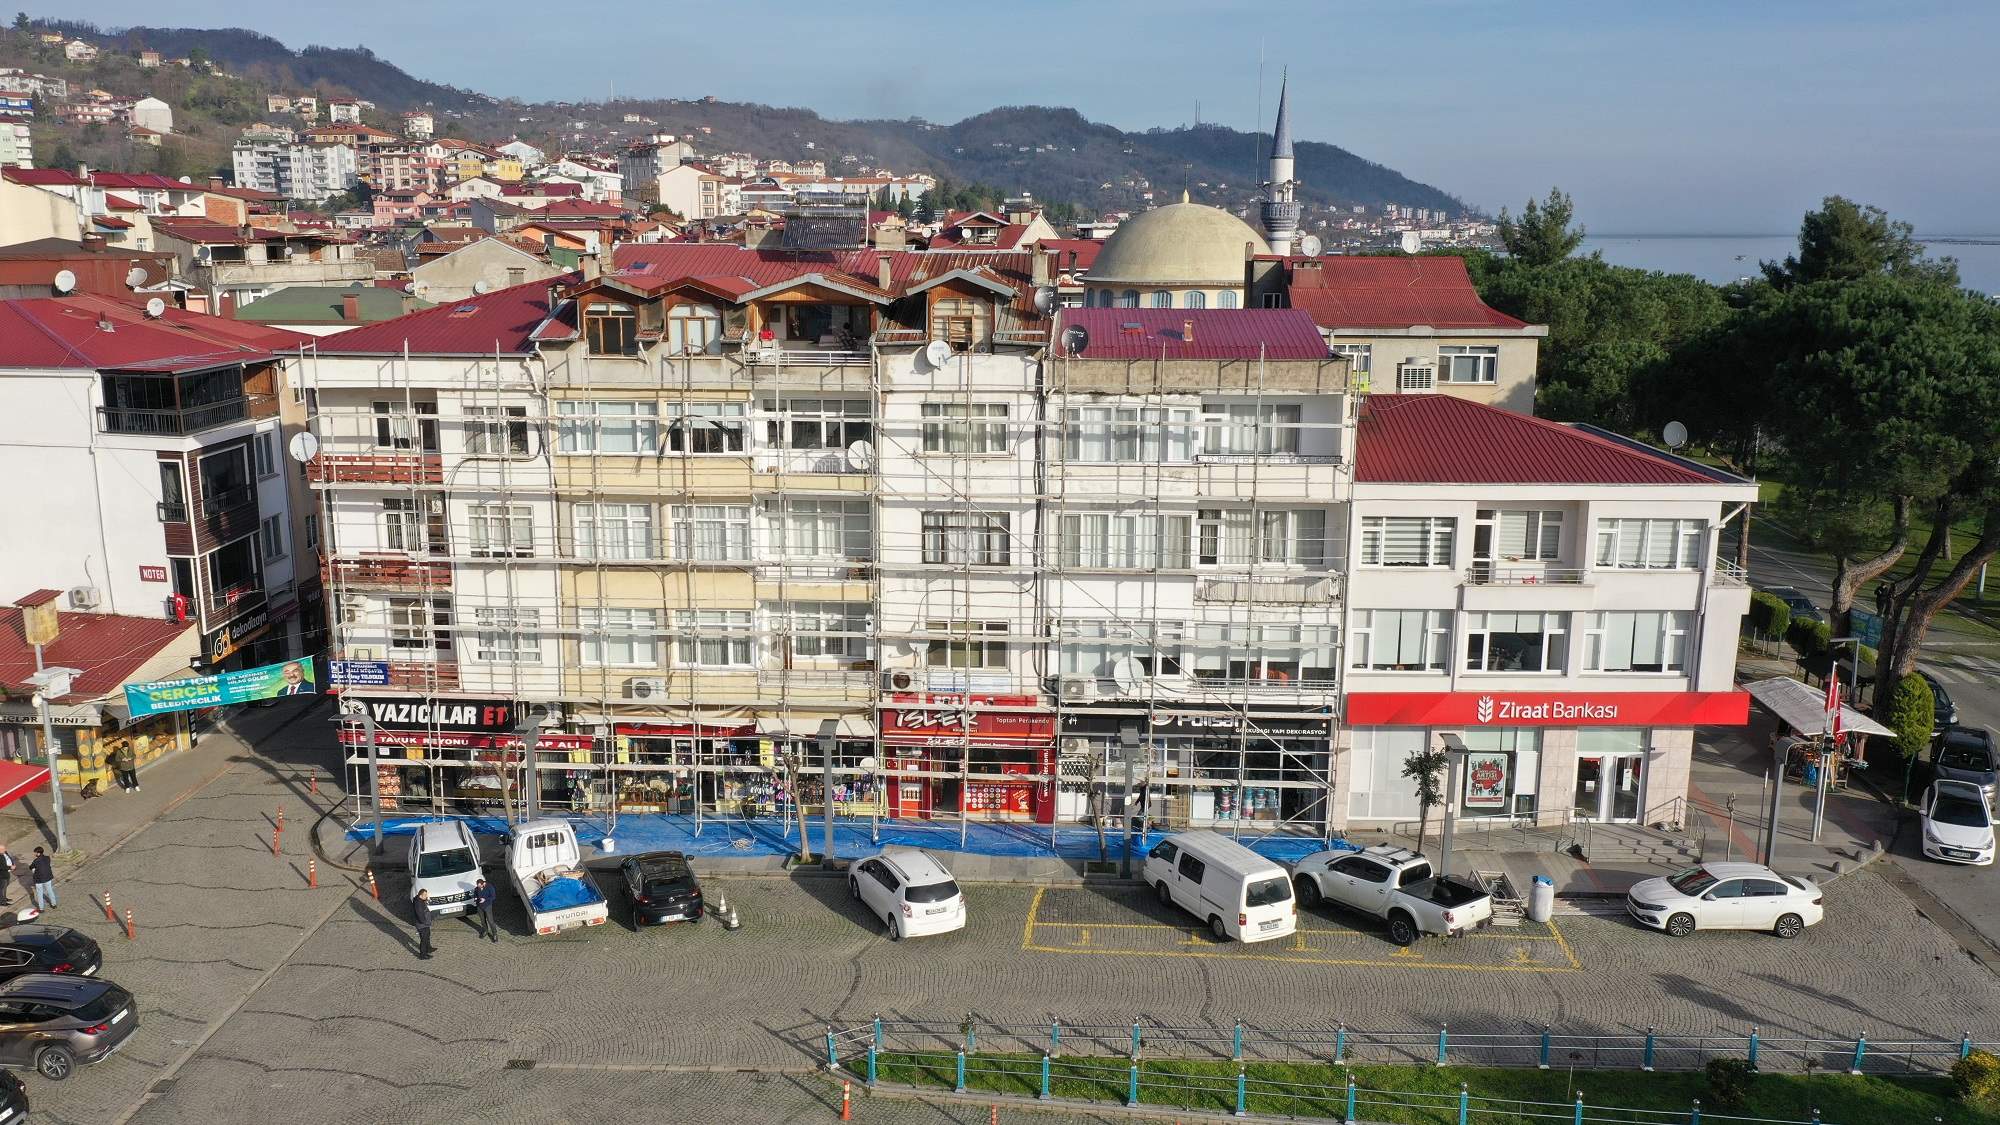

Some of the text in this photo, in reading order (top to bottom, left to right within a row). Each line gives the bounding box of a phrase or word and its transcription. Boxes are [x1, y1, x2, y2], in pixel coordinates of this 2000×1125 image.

[143, 568, 165, 579] NOTER
[232, 611, 267, 638] dekodizayn
[373, 703, 507, 726] YAZICILAR ET
[1498, 700, 1617, 719] Ziraat Bankası
[996, 717, 1018, 725] Toptan
[380, 736, 418, 744] TAVUK
